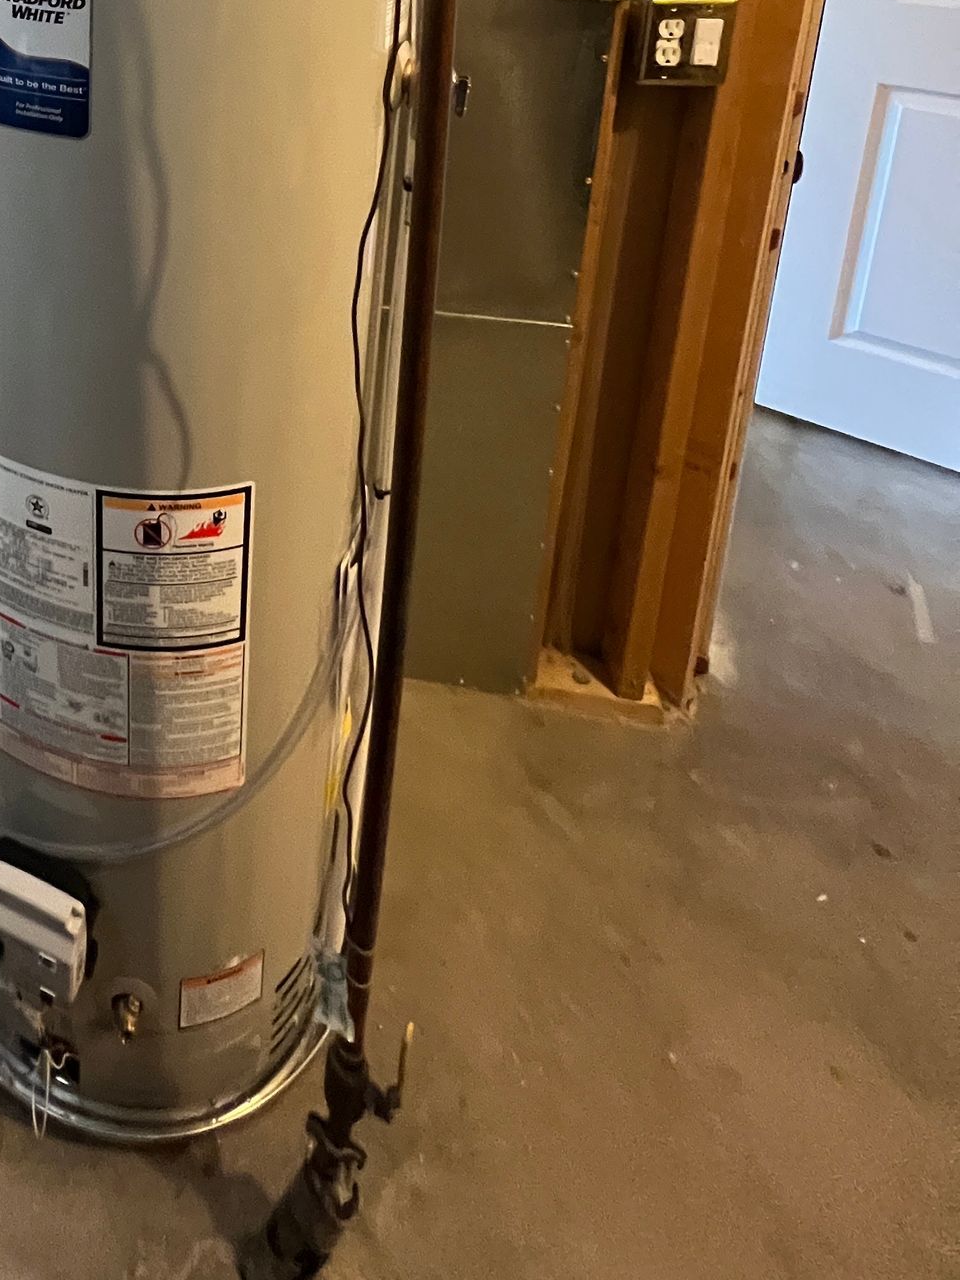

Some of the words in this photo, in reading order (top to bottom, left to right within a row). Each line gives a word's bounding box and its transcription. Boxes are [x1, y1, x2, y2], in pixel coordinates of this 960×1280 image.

[12, 4, 65, 25] WHITE
[15, 78, 24, 86] to
[26, 80, 39, 89] be
[41, 82, 57, 91] the
[59, 84, 83, 95] Best
[159, 503, 202, 511] WARNING
